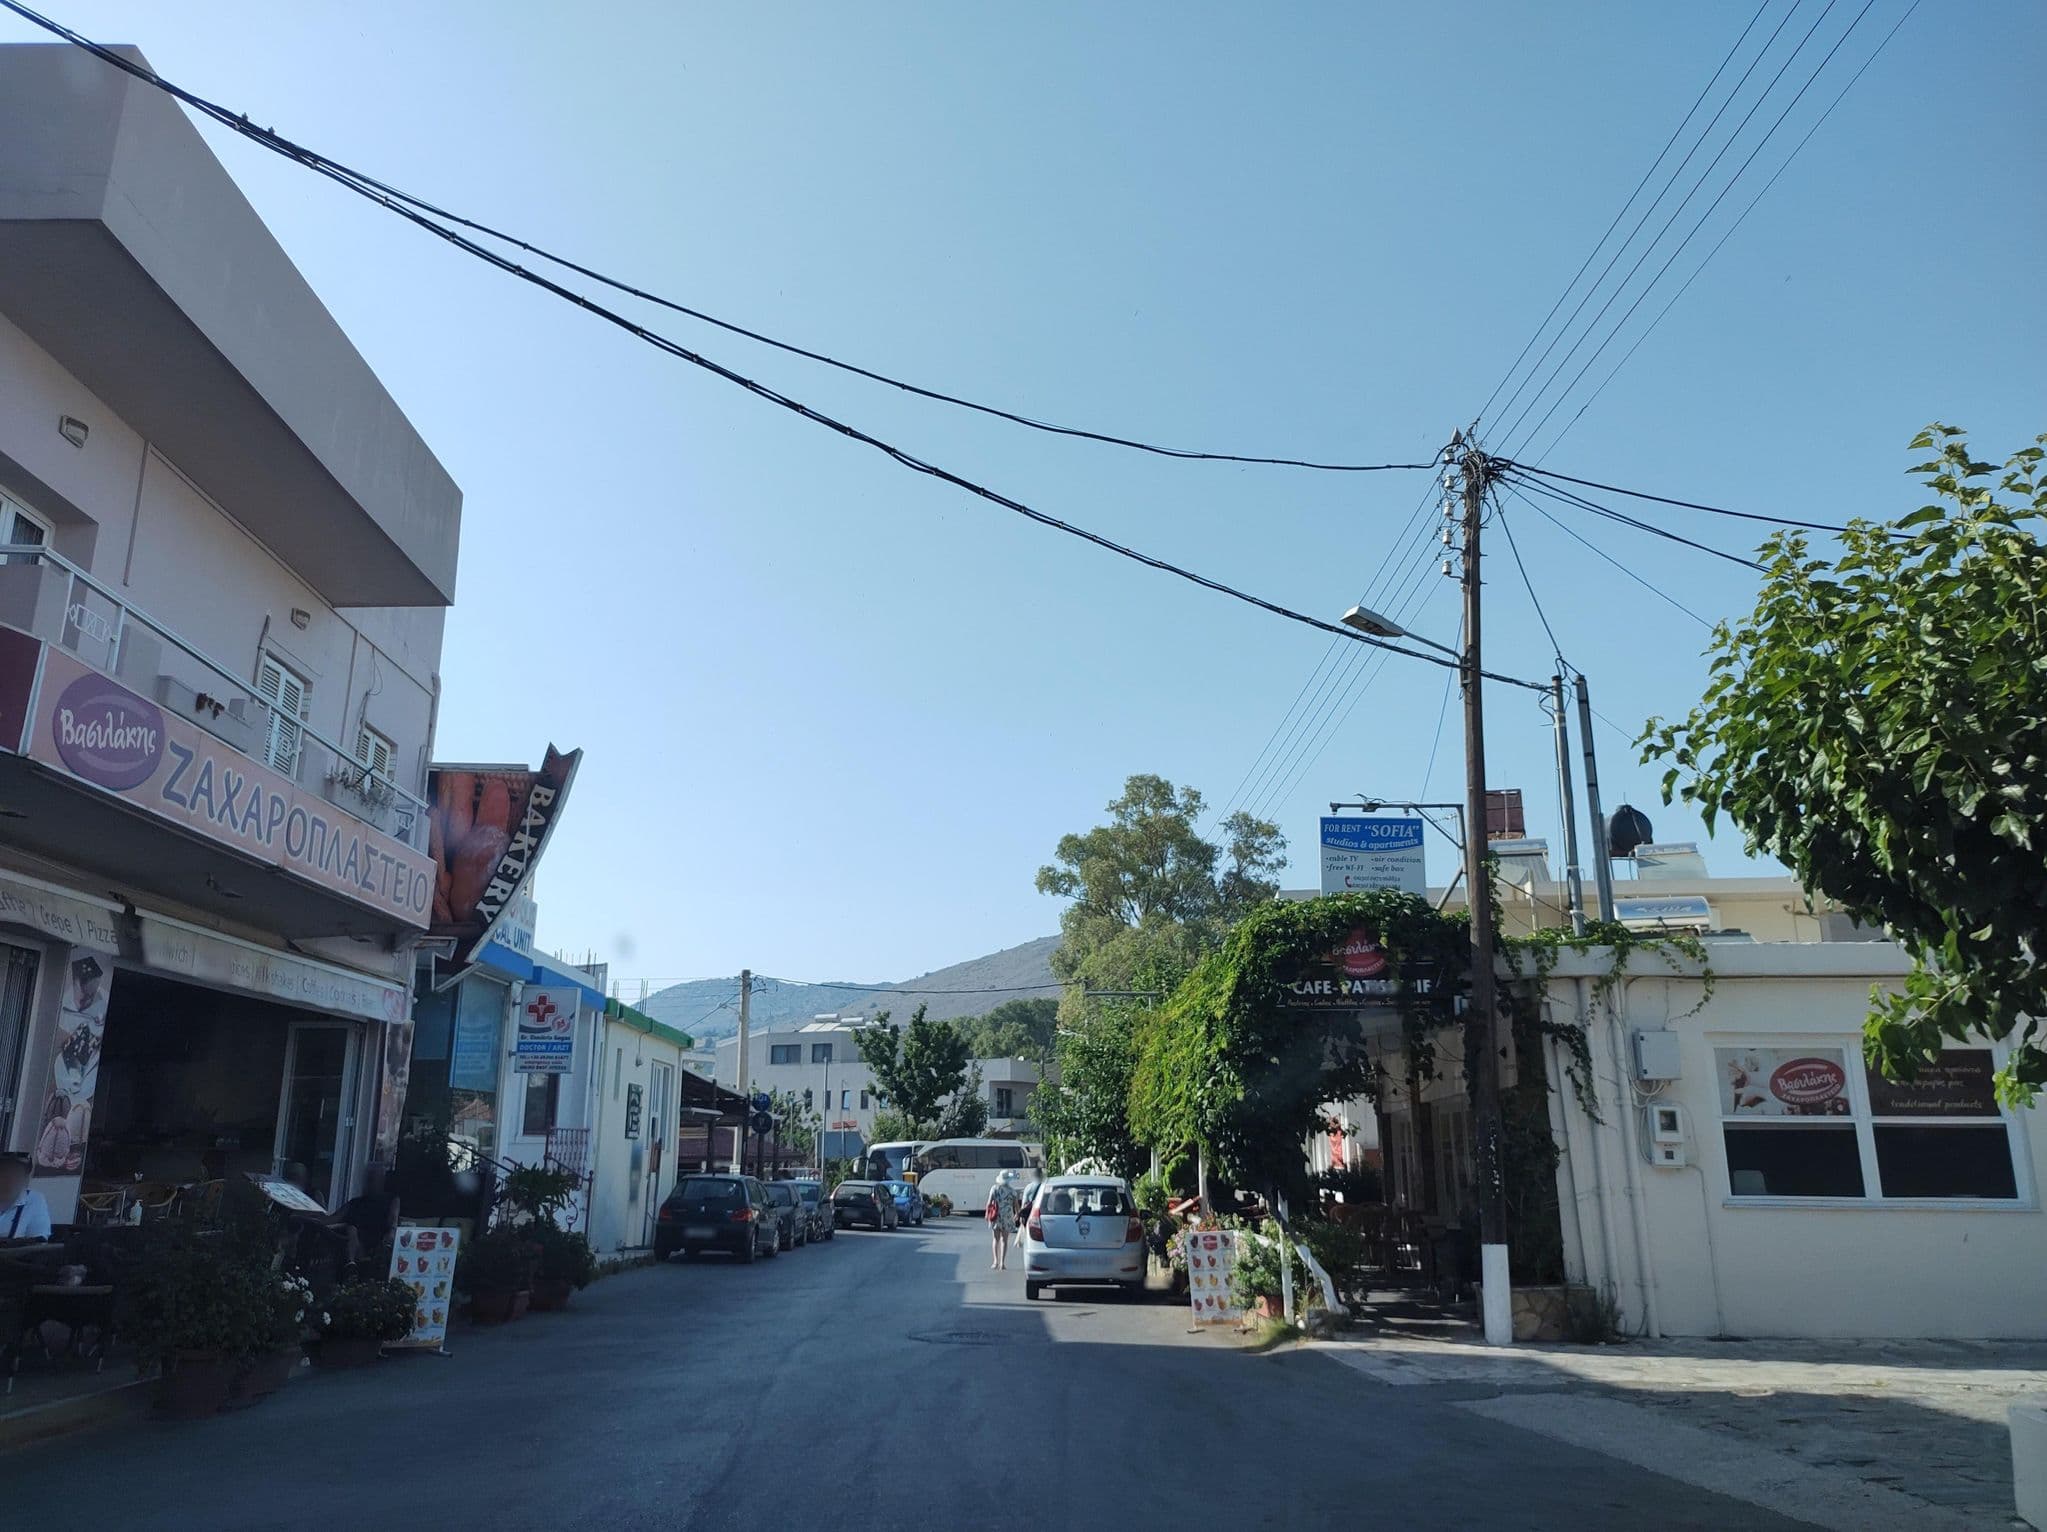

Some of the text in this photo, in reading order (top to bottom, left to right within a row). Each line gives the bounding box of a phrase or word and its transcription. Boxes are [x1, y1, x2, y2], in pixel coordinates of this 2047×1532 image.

[60, 708, 157, 758] Βασιλάκης
[161, 739, 429, 915] ΖΑΧΑΡΟΠΛΑΣΤΕΙΟ
[1324, 823, 1340, 833] FOR
[1341, 824, 1362, 833] RENT
[476, 783, 556, 924] BAKERY
[1326, 837, 1419, 851] studios & apartments
[87, 919, 118, 945] Pizza
[513, 926, 532, 956] UNIT
